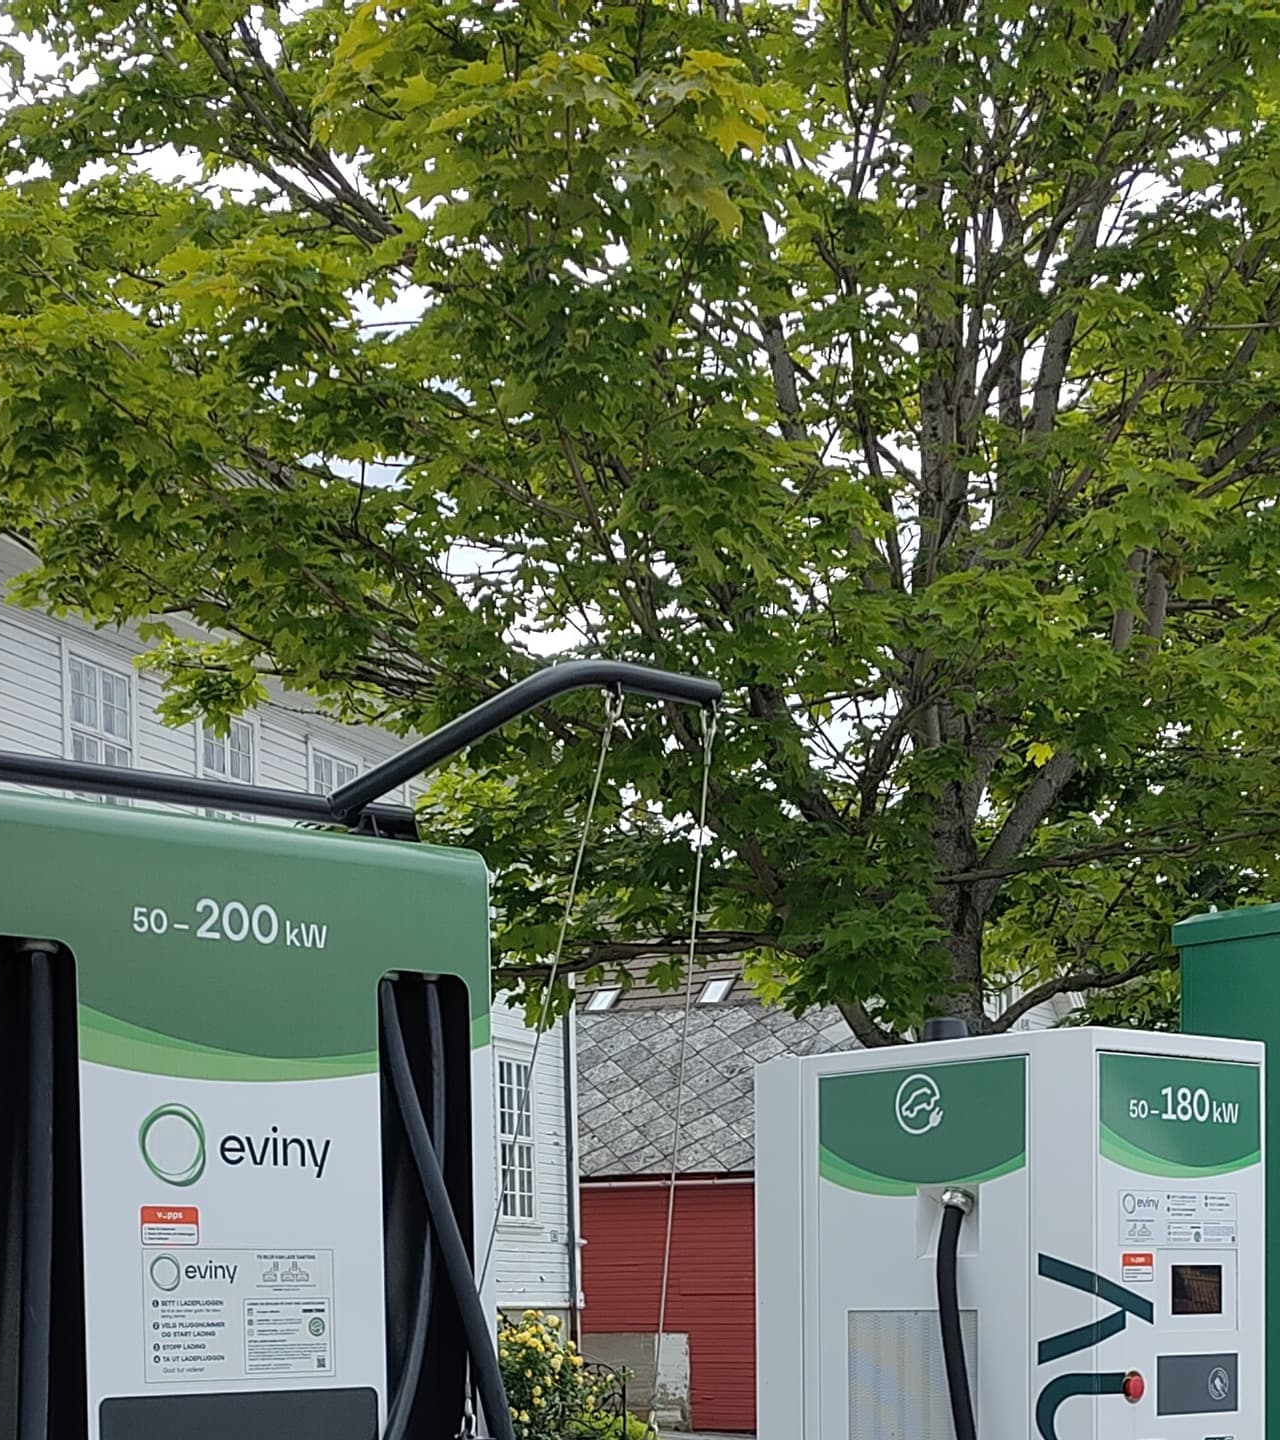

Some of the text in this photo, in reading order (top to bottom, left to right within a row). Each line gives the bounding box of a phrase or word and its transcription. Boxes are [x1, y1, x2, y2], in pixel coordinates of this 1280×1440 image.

[285, 919, 328, 949] kW
[1213, 1100, 1240, 1124] kW
[219, 1126, 331, 1179] eviny
[1136, 1196, 1160, 1211] eviny
[184, 1259, 238, 1284] eviny
